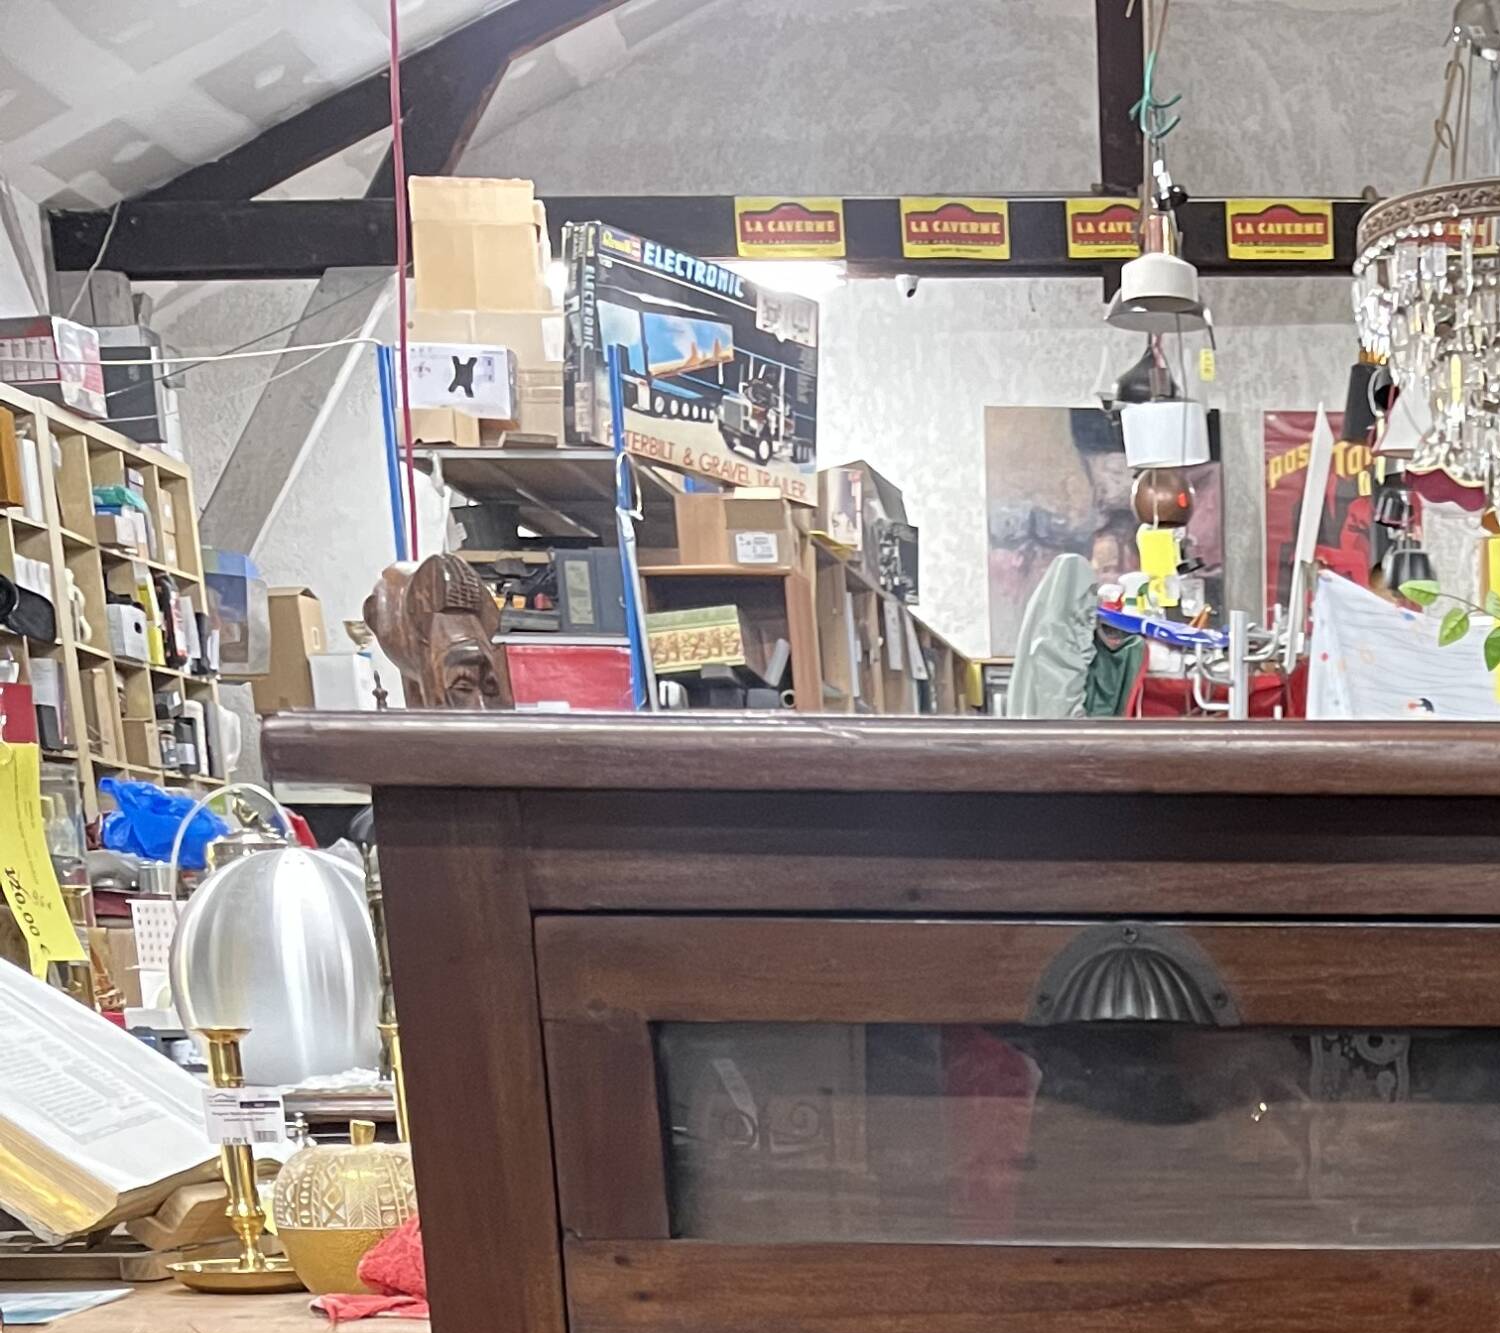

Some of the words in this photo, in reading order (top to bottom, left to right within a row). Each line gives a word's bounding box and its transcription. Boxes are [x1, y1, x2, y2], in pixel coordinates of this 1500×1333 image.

[744, 220, 764, 233] LA
[767, 220, 836, 233] CAVERNE
[910, 221, 929, 233] LA
[932, 221, 1001, 235] CAVERNE
[1076, 221, 1095, 234] LA
[1234, 222, 1255, 235] LA
[1257, 222, 1325, 235] CAVERNE
[643, 241, 745, 298] ELECTRONIC
[583, 264, 596, 350] ELECTRONIC
[605, 423, 676, 460] PTERBILT
[682, 447, 694, 467] &
[698, 453, 752, 484] GRAVEL
[756, 468, 808, 499] TRAILER
